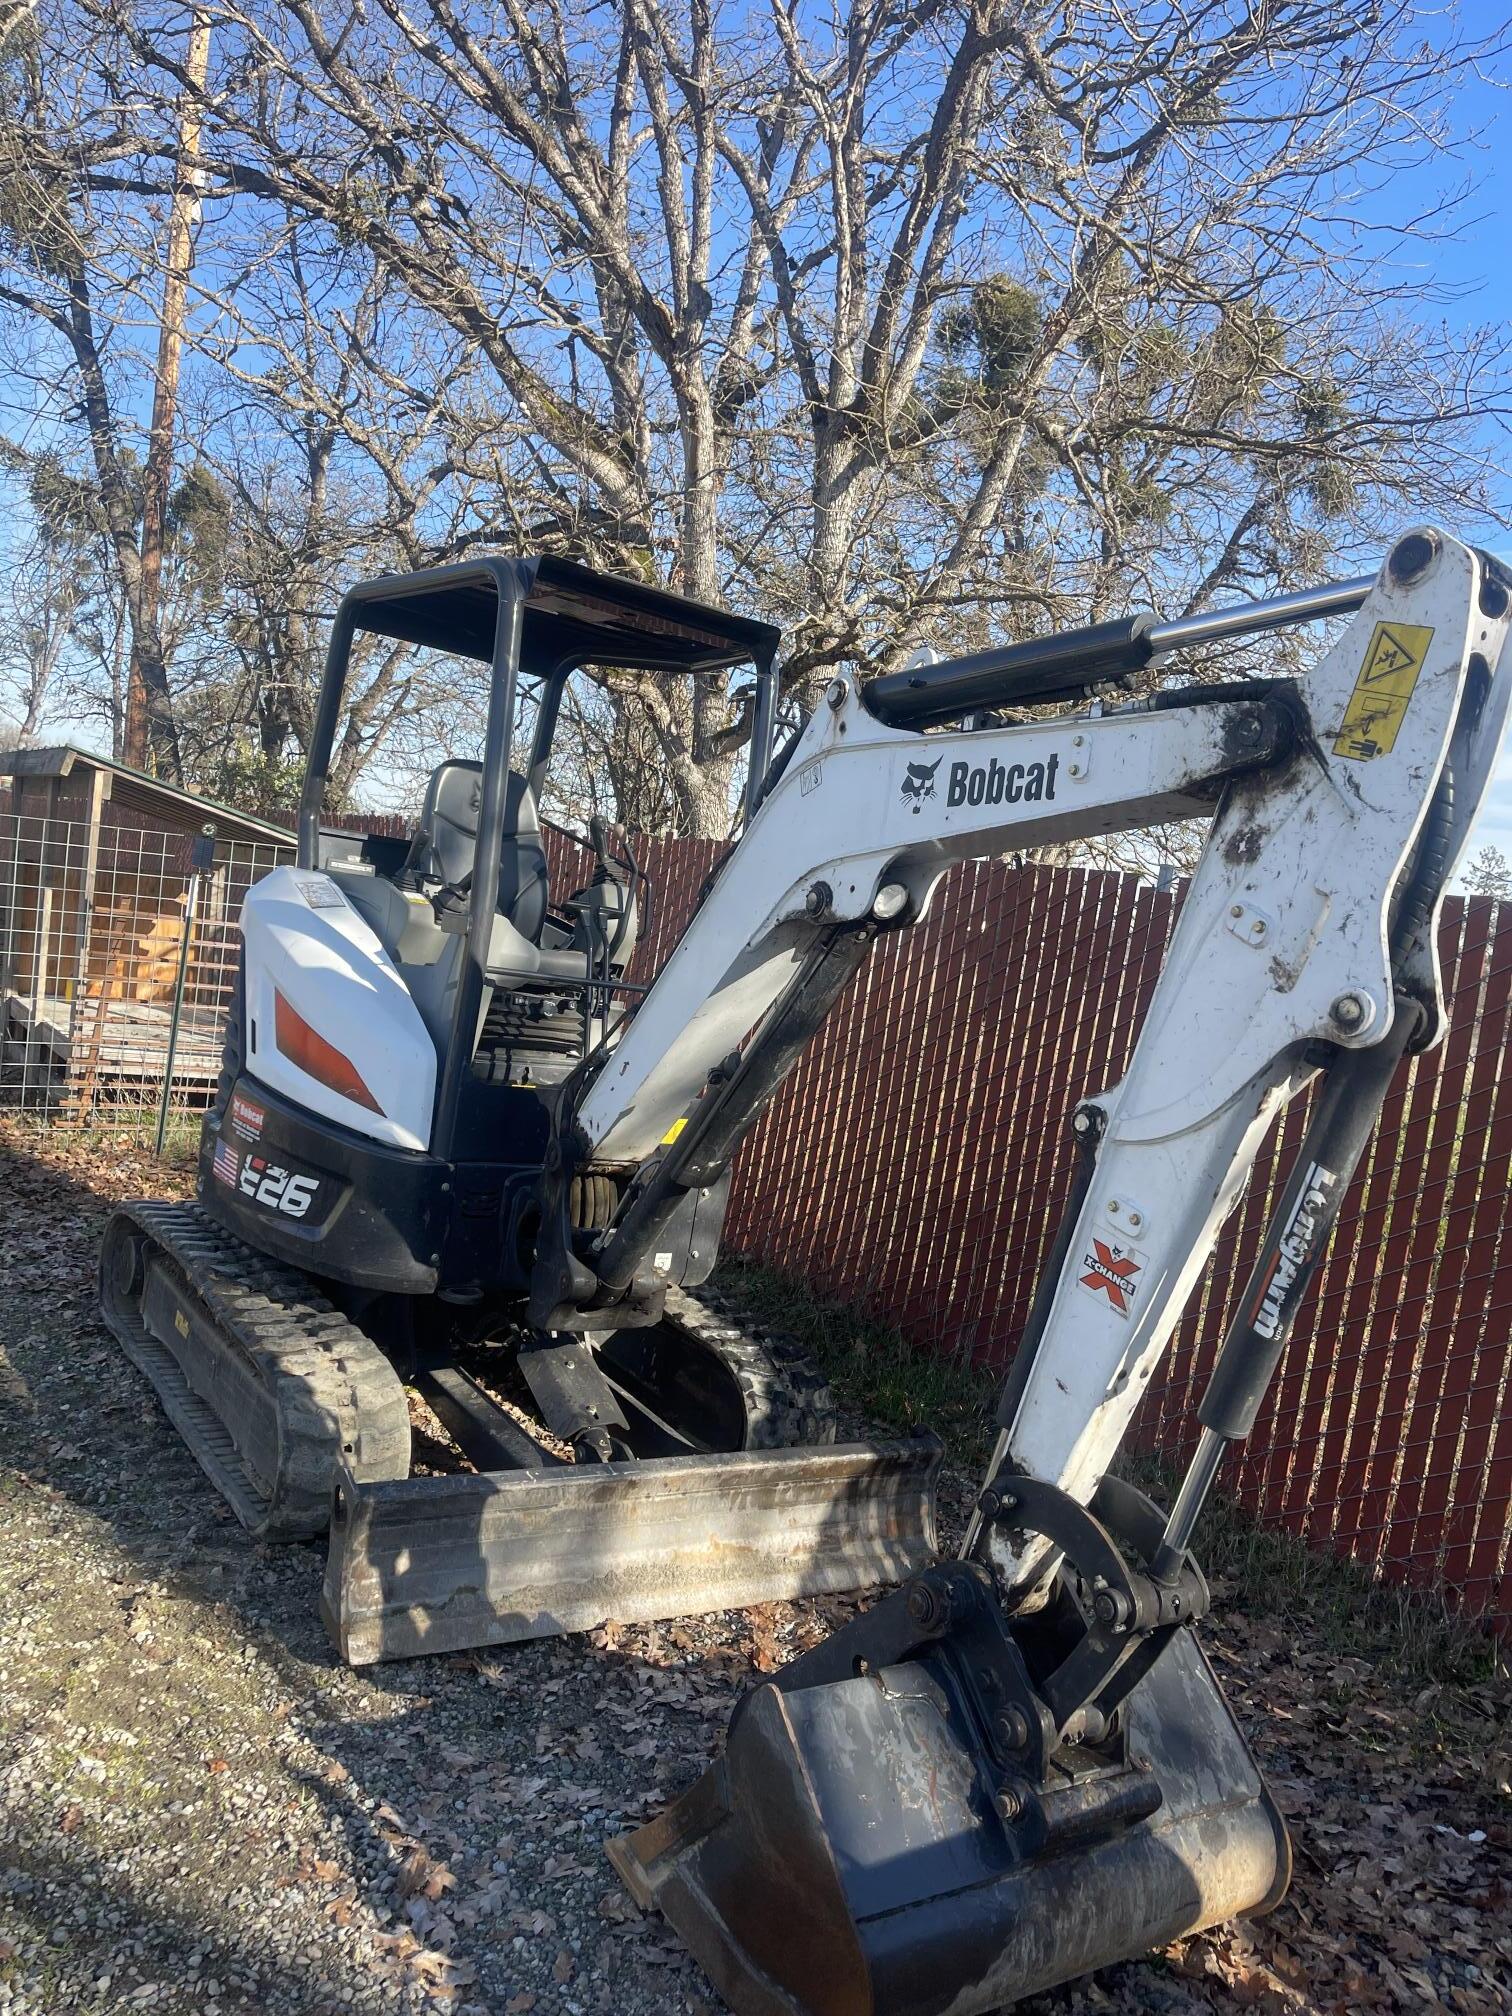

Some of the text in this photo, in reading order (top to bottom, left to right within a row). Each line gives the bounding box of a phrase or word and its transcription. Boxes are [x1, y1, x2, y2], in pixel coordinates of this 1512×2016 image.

[947, 753, 1059, 808] Bobcat
[239, 1154, 320, 1218] E26
[1085, 1255, 1134, 1294] X-CHANGE
